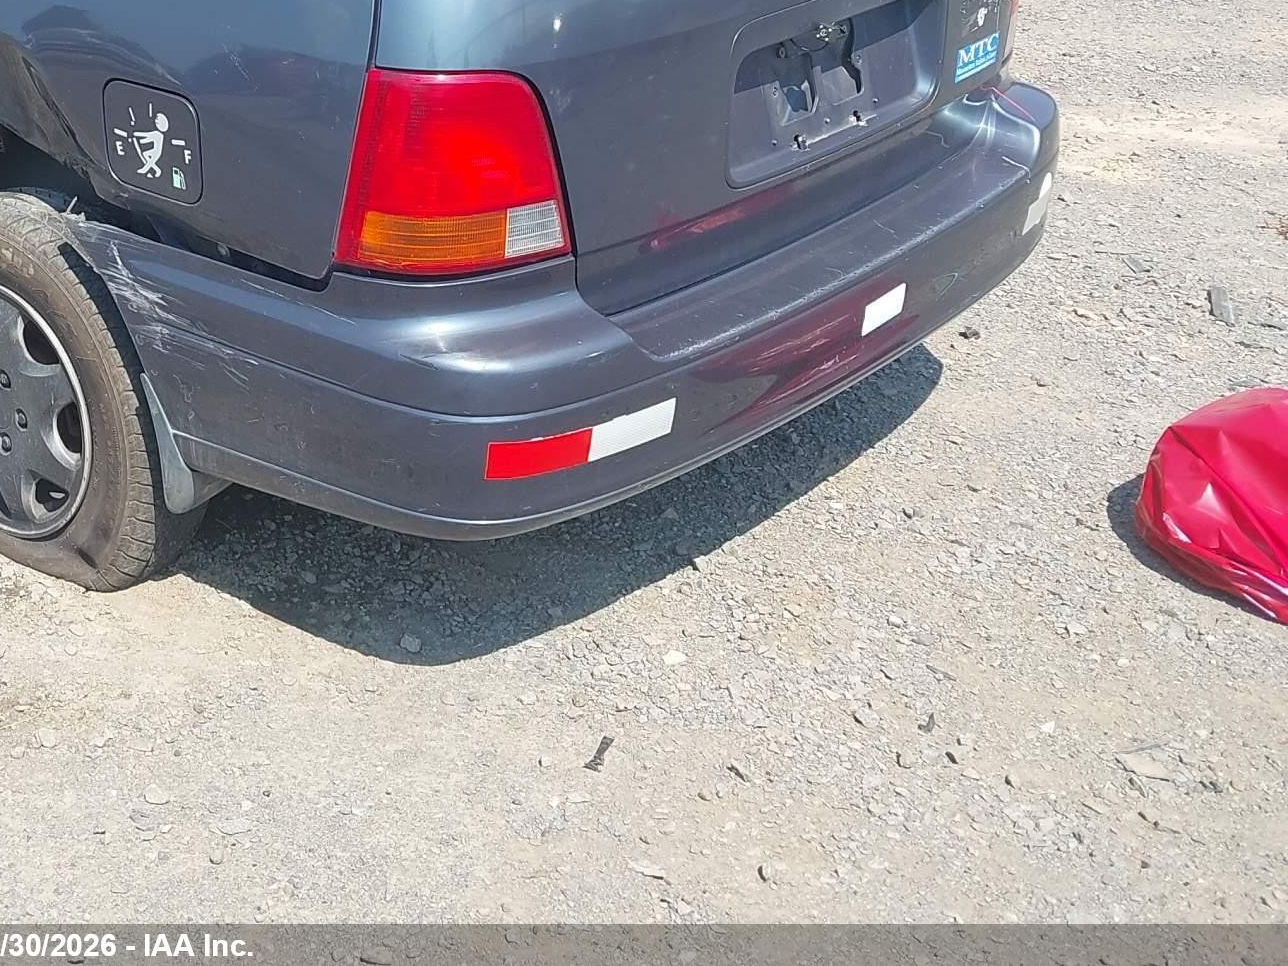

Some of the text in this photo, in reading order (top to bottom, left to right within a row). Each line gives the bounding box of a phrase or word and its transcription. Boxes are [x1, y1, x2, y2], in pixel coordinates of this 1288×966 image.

[958, 33, 1000, 66] MTC
[115, 140, 125, 156] E
[183, 149, 192, 165] F
